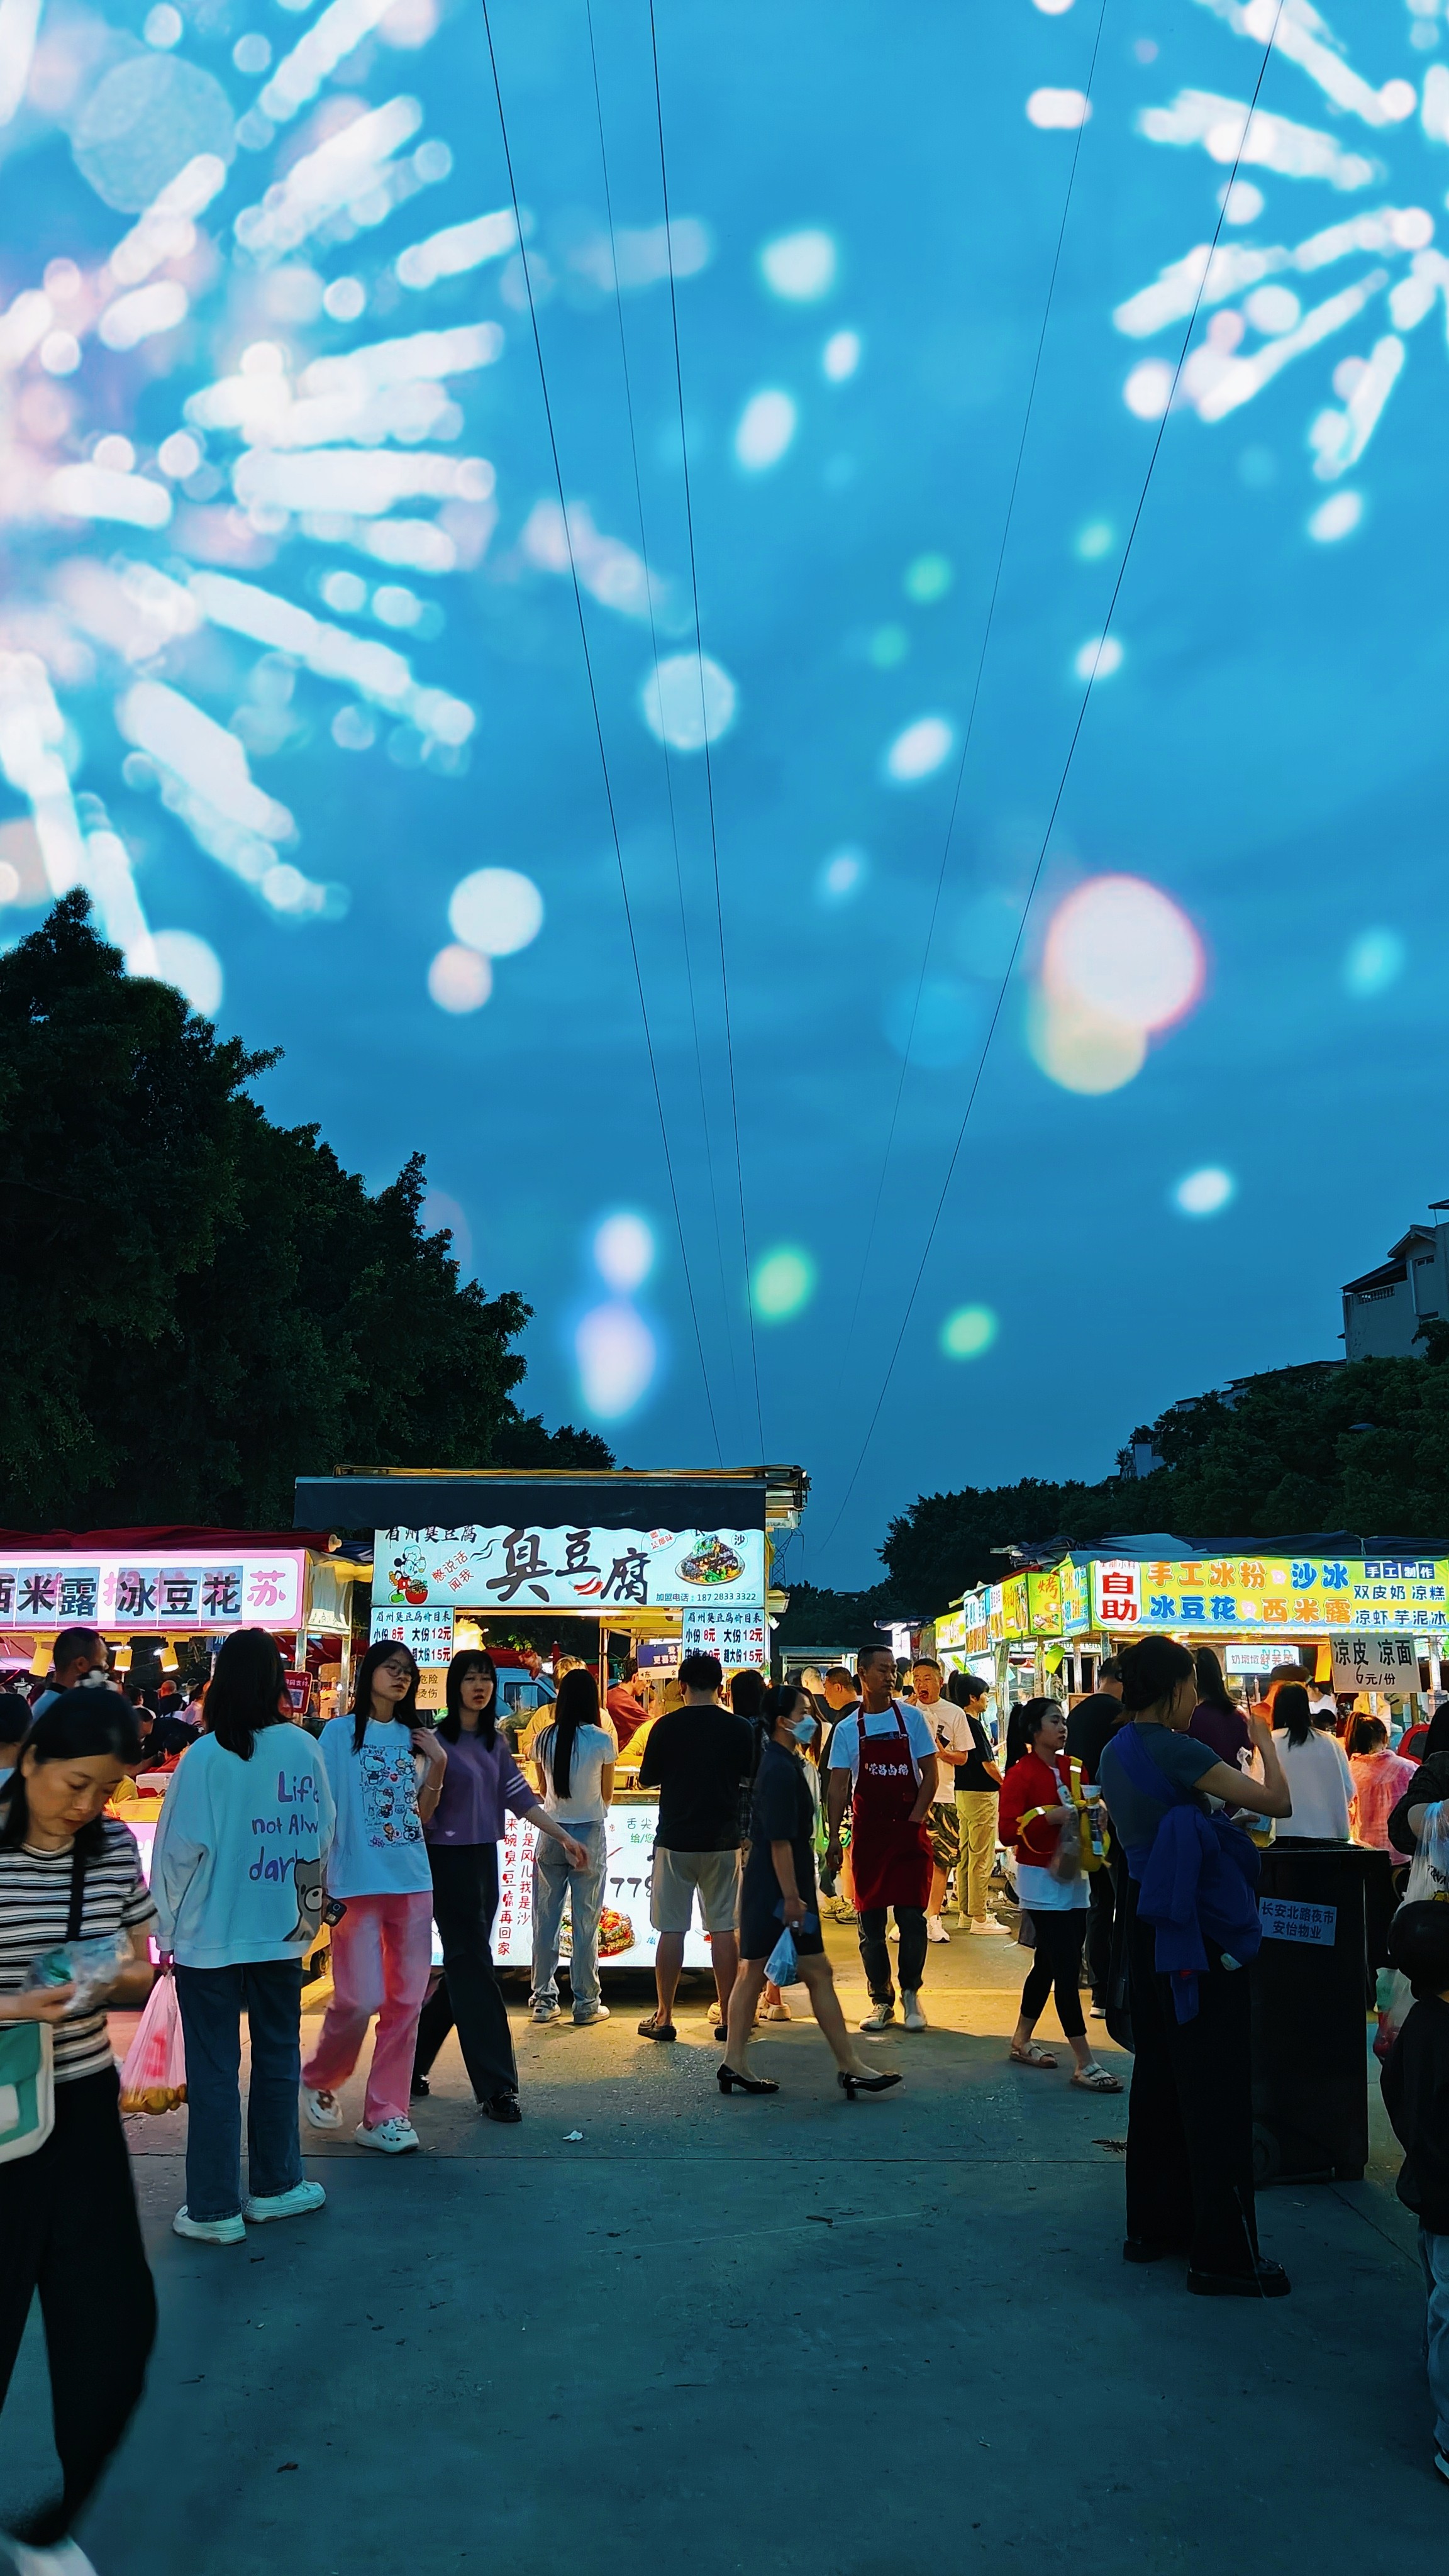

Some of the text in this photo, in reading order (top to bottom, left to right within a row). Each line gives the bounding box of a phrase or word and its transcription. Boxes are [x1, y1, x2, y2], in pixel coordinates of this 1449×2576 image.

[734, 1534, 745, 1545] 沙
[486, 1528, 652, 1605] 臭豆腐
[1148, 1562, 1349, 1589] 手工冰粉 沙冰
[1366, 1565, 1434, 1579] 手工制作
[447, 1568, 474, 1592] 闻我
[1038, 1575, 1058, 1599] 烤
[118, 1575, 240, 1616] 冰豆花
[247, 1570, 286, 1607] 苏
[714, 1593, 734, 1601] 2833
[1101, 1572, 1138, 1621] 自助
[1354, 1585, 1446, 1601] 双皮奶 凉糕
[1150, 1595, 1351, 1624] 冰豆花 西米露
[1355, 1610, 1446, 1626] 凉虾 芋泥冰
[392, 1626, 404, 1641] 8元
[412, 1627, 430, 1642] 大份
[432, 1626, 452, 1641] 12元
[686, 1628, 763, 1643] 小份 8元 大份 12元
[431, 1647, 451, 1662] 15元
[653, 1655, 677, 1665] 更喜欢
[723, 1648, 742, 1663] 超大份
[743, 1648, 763, 1663] 15元
[1333, 1638, 1413, 1666] 凉皮 凉面
[420, 1674, 438, 1684] 危险
[1355, 1665, 1396, 1685] 6元/份
[418, 1688, 438, 1699] 烫伤
[252, 1816, 282, 1835] not
[626, 1818, 652, 1830] 舌尖
[249, 1846, 299, 1883] dar
[517, 1819, 536, 1925] 你是风儿我是沙
[497, 1817, 518, 1955] 来碗臭豆腐再回家
[1261, 1901, 1334, 1924] 长安北路夜市
[1273, 1920, 1321, 1940] 安怡物业
